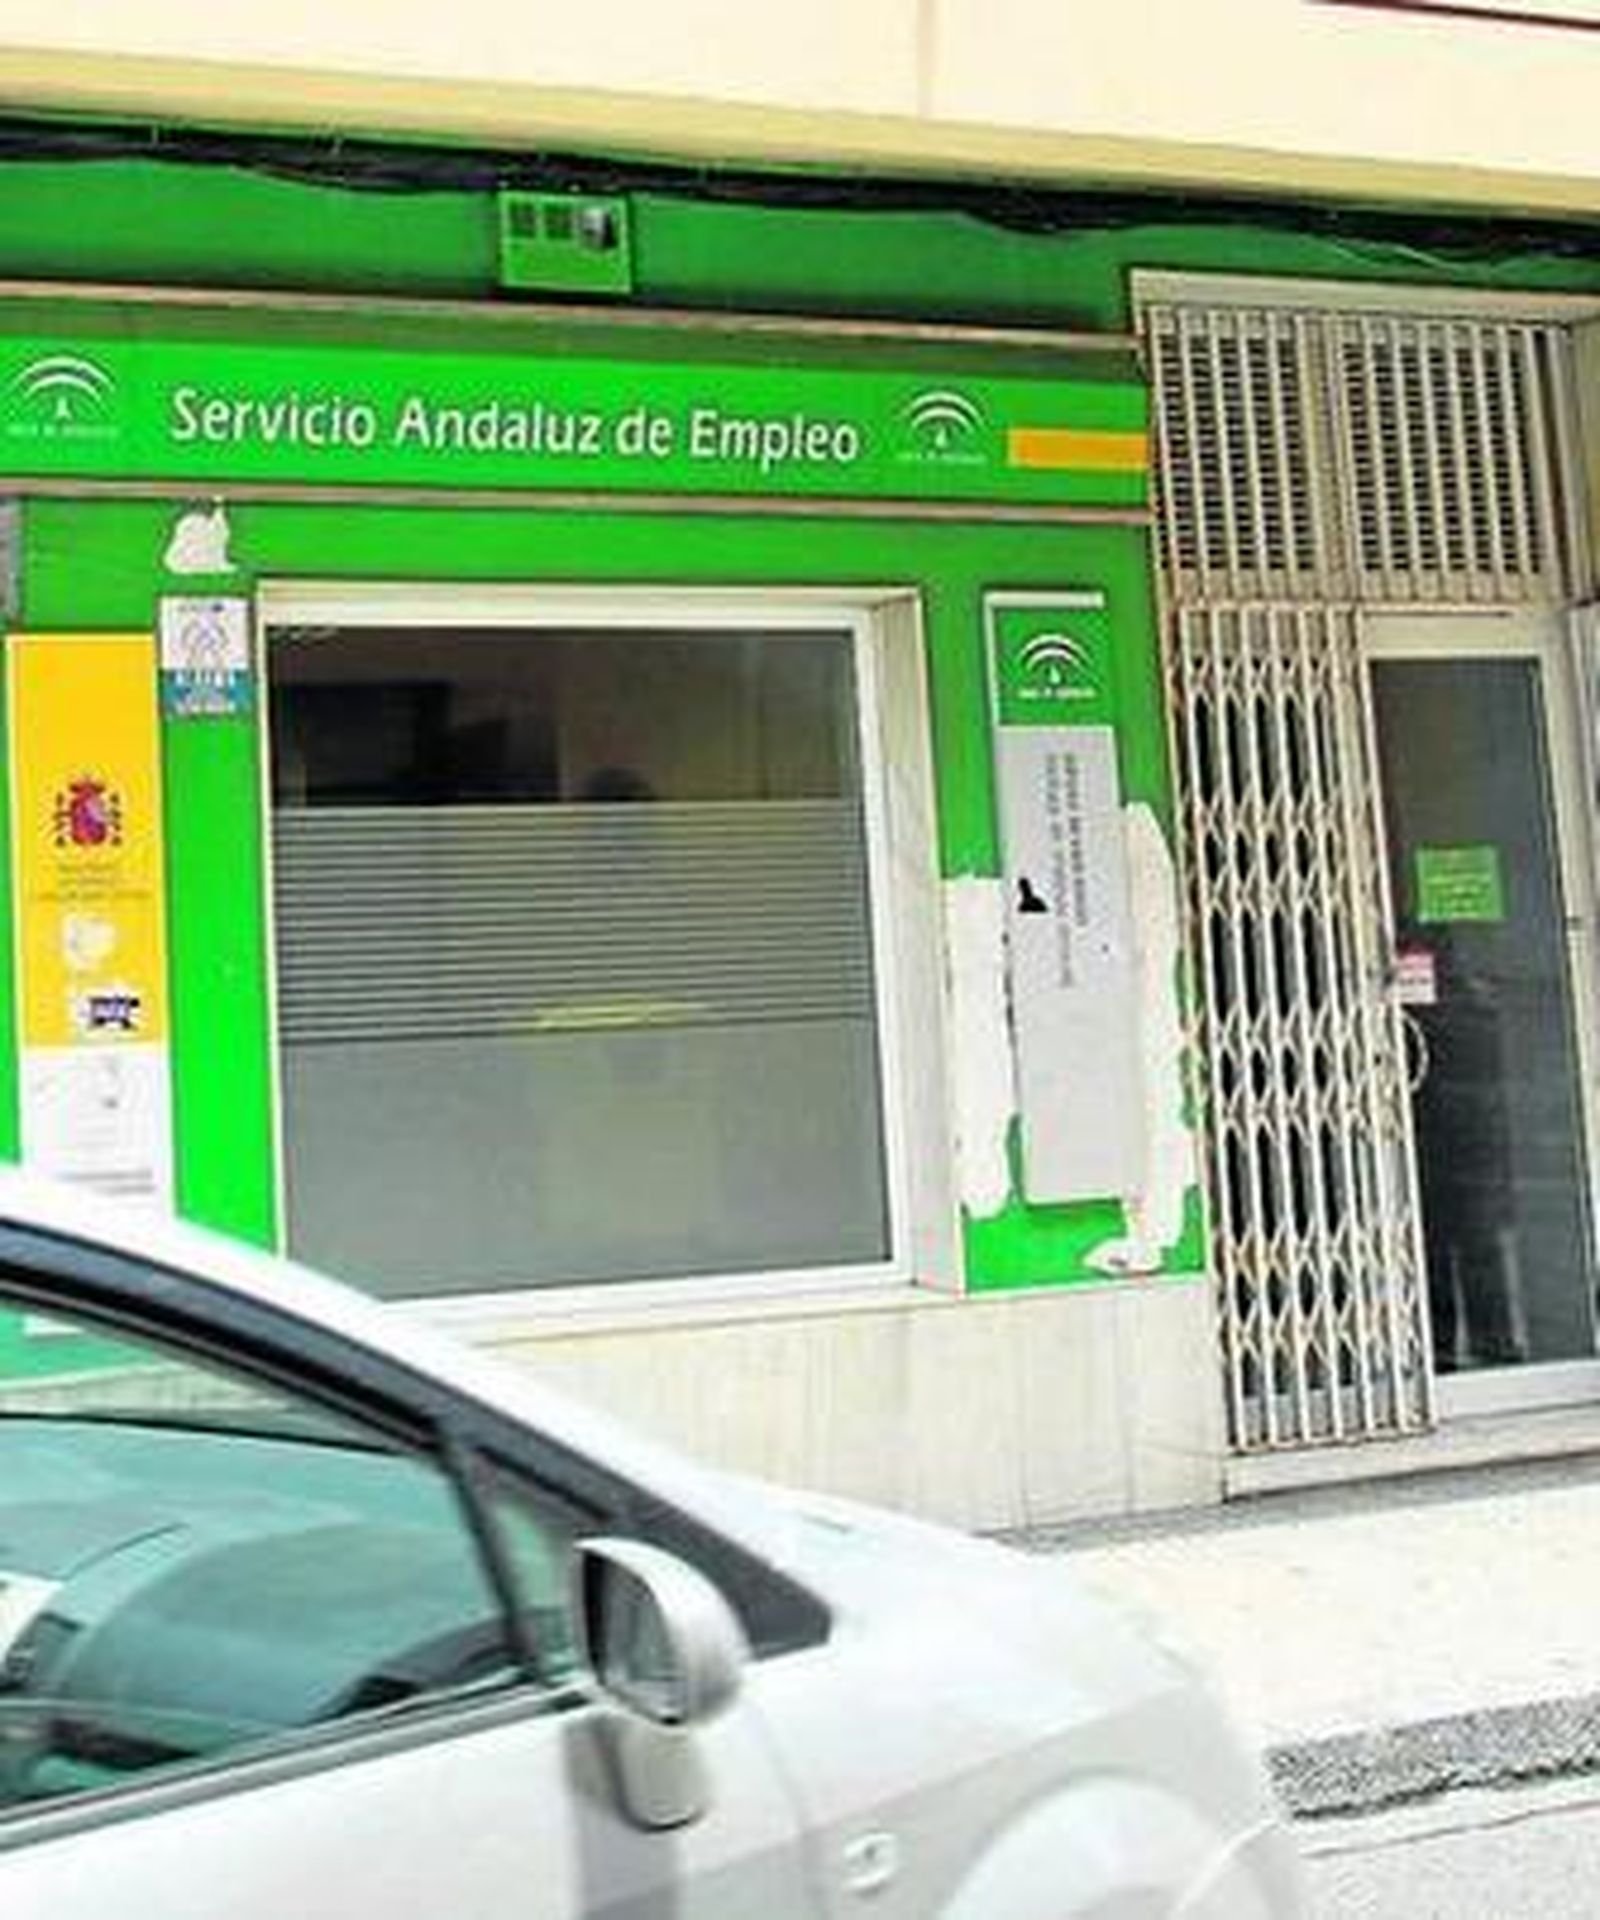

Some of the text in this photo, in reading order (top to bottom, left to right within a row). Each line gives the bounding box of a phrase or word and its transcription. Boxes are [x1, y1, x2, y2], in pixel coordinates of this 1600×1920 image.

[172, 387, 859, 473] Servicio Andaluz de Empleo
